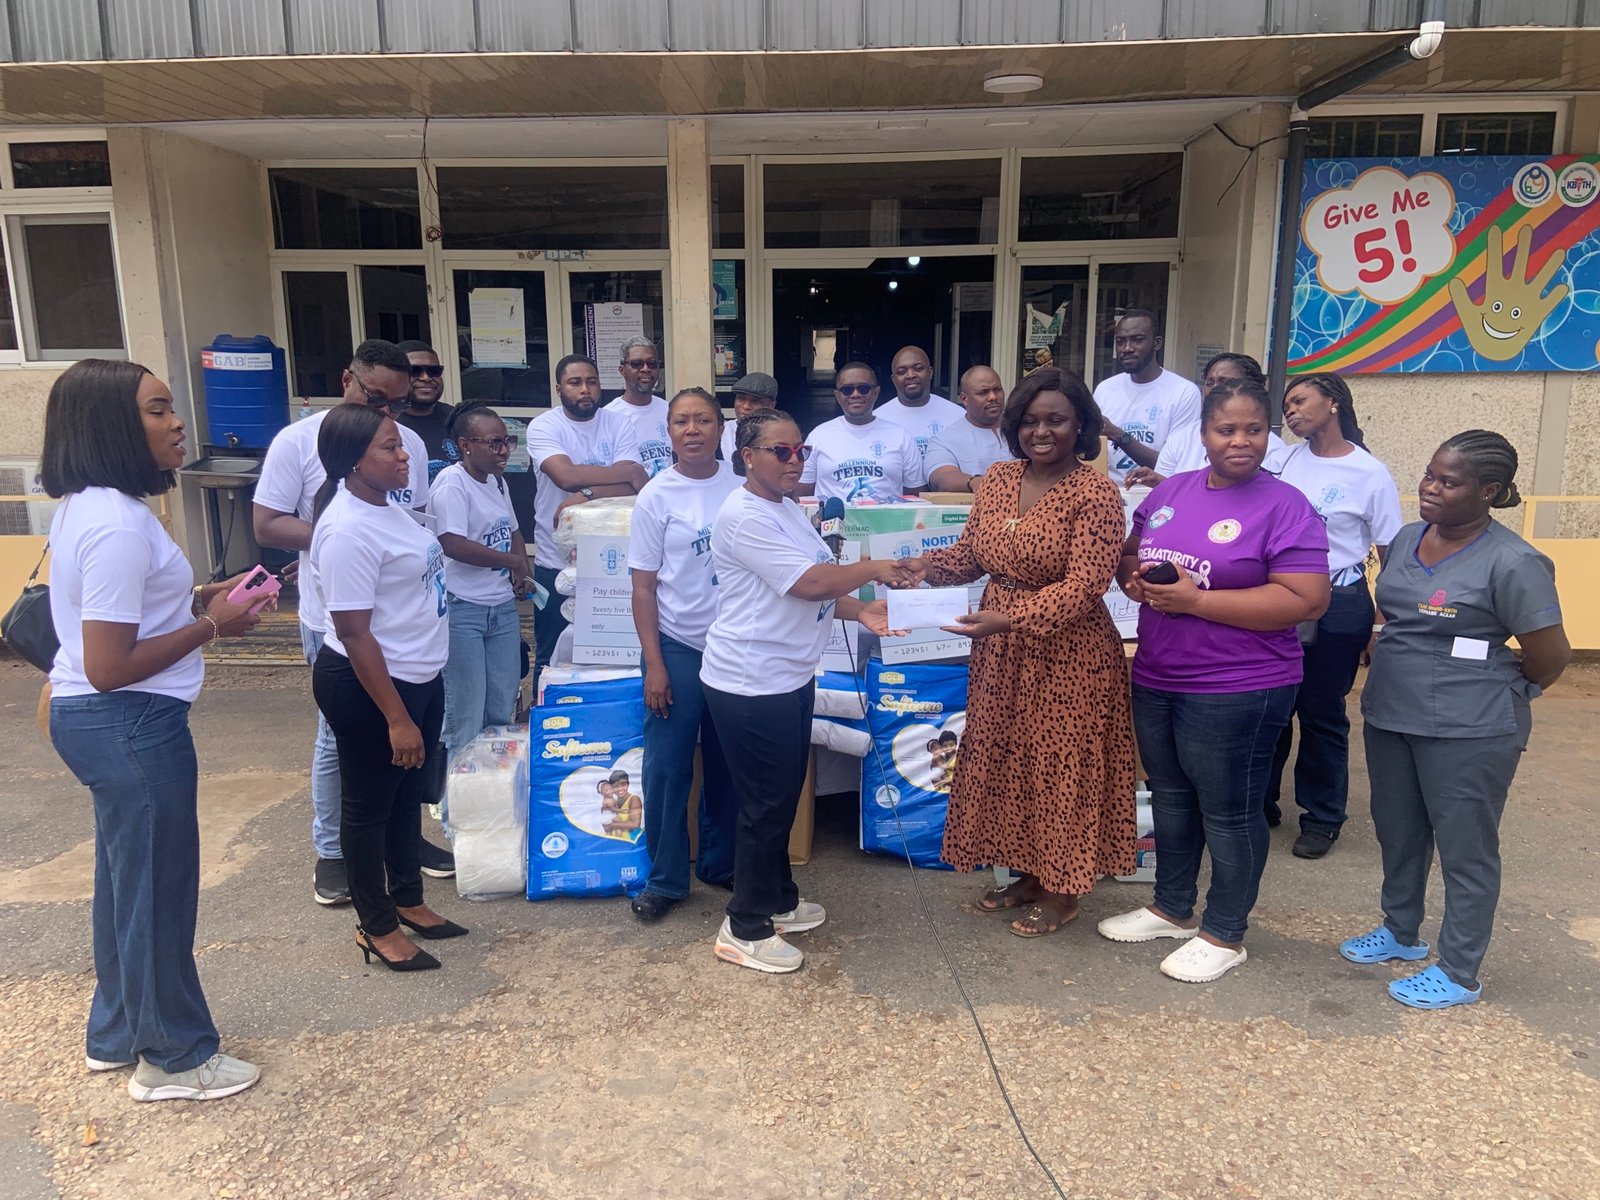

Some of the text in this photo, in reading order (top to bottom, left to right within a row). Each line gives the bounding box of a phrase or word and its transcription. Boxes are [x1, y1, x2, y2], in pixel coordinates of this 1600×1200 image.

[1323, 188, 1430, 229] Give Me
[1353, 219, 1417, 283] 5!
[214, 355, 245, 367] GAB
[1128, 430, 1154, 443] ENS
[640, 446, 672, 462] EENS
[838, 460, 876, 468] MILLENNIUM
[833, 465, 883, 482] TEENS
[593, 587, 607, 596] Pay
[543, 718, 569, 728] GOLD
